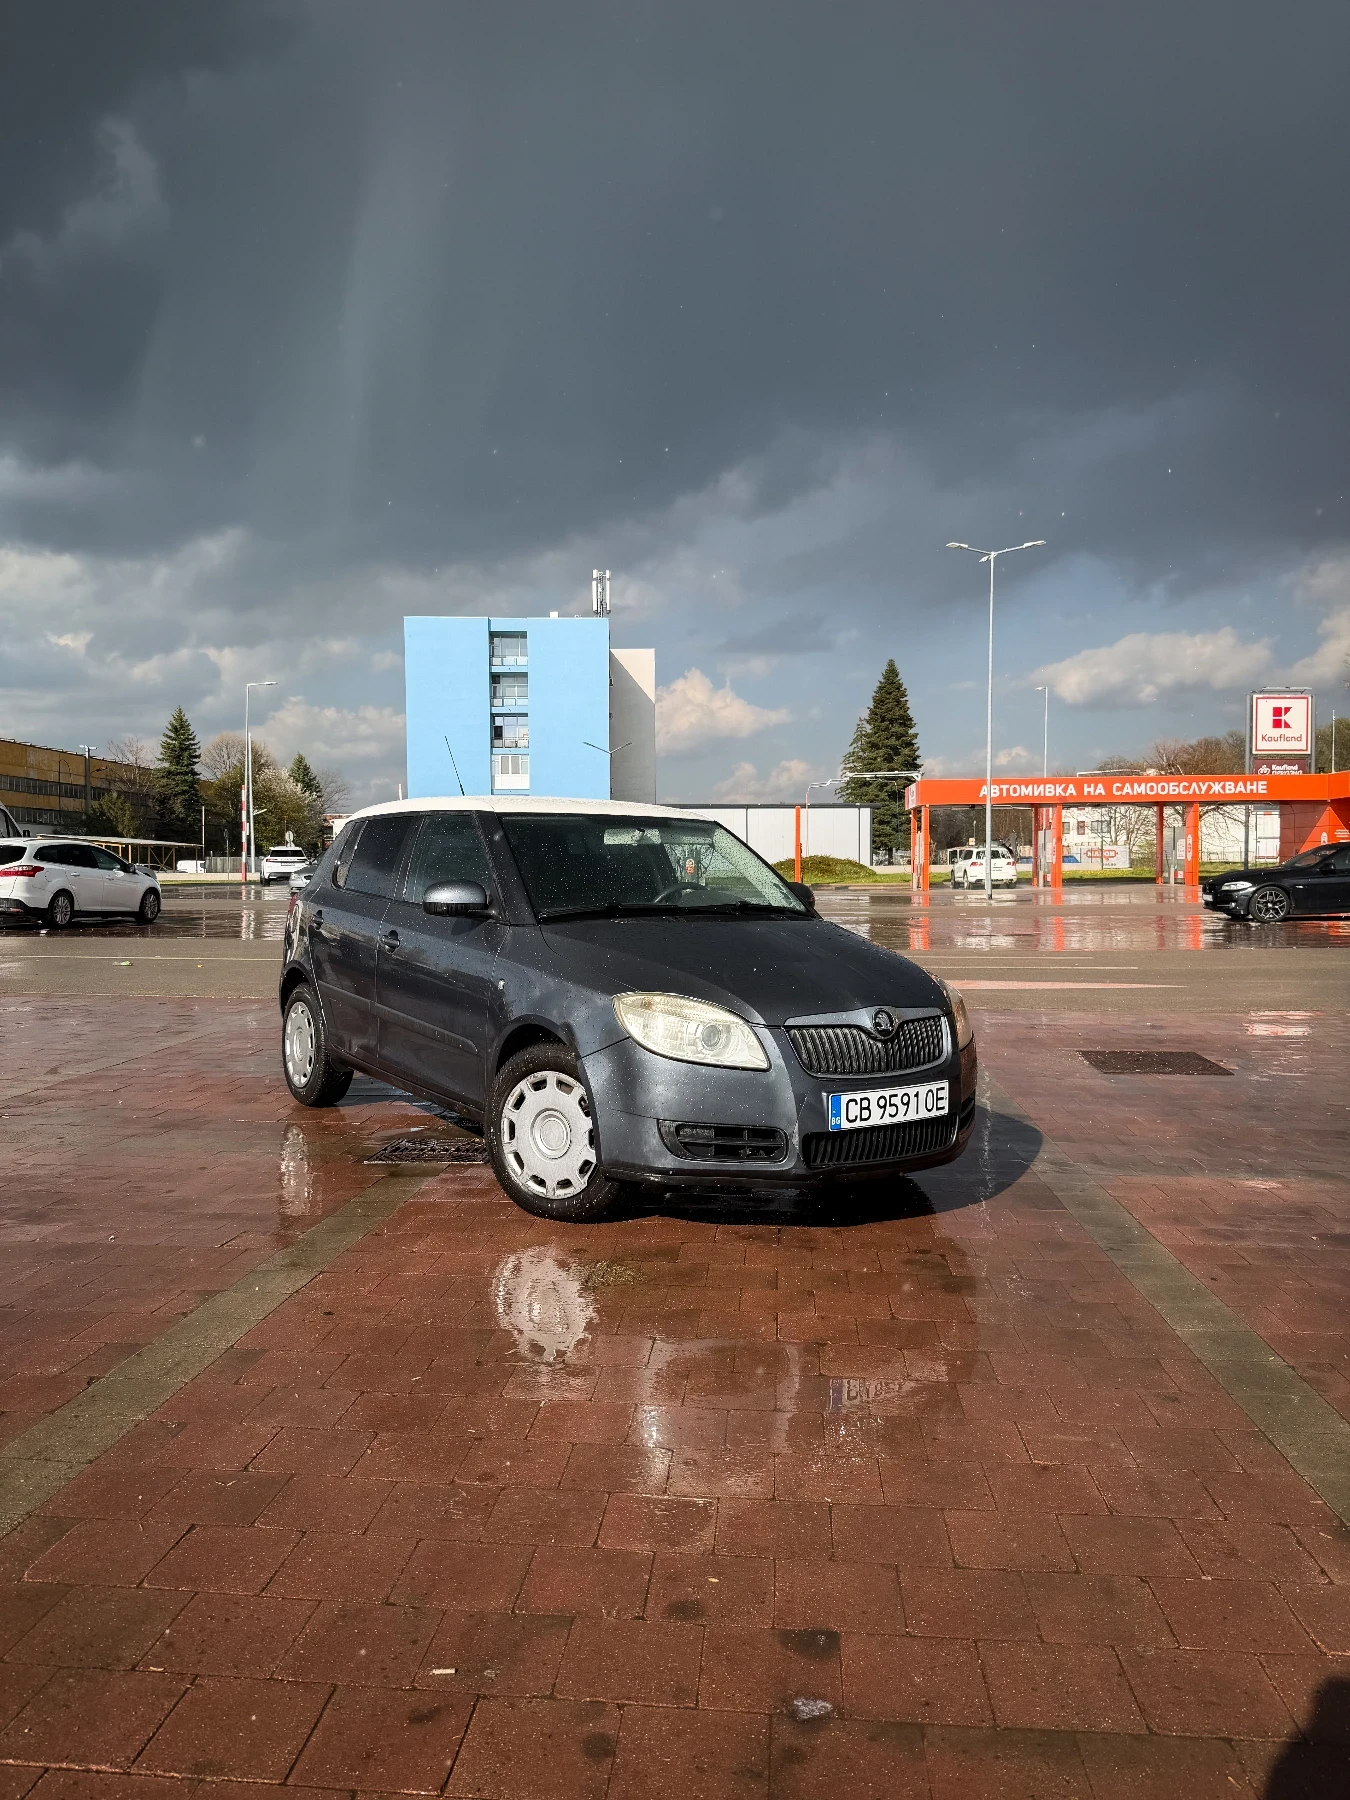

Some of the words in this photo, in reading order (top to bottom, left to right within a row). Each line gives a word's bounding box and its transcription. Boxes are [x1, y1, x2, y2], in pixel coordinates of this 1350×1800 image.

[1261, 734, 1303, 742] Kaufland
[978, 783, 1077, 798] АВТОМИВКА
[1083, 783, 1106, 796] НА
[1112, 781, 1268, 796] САМООБСЛУЖВАНЕ
[845, 1097, 872, 1123] CB
[876, 1091, 919, 1120] 9591
[832, 1117, 841, 1126] BG
